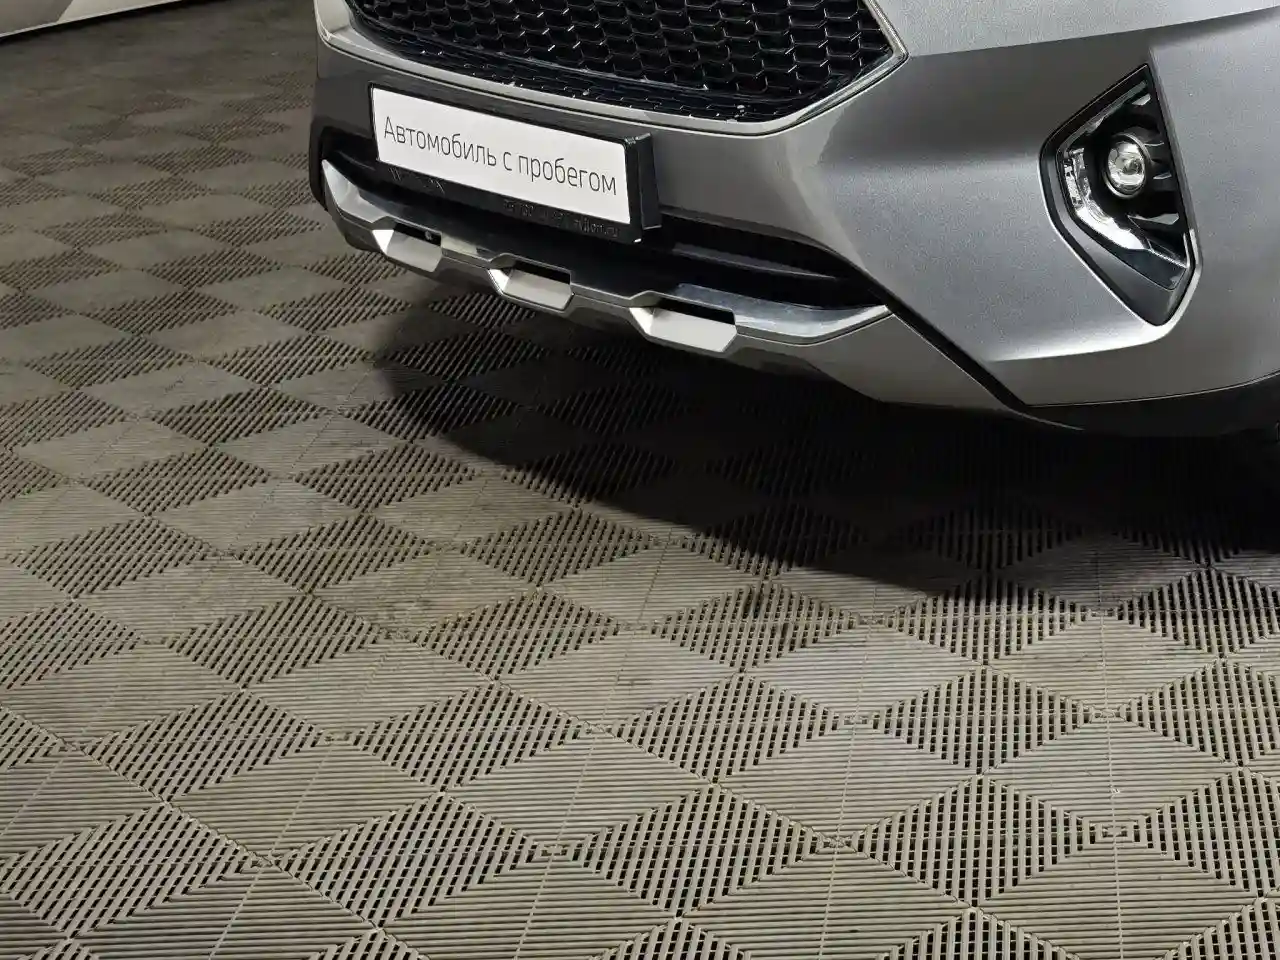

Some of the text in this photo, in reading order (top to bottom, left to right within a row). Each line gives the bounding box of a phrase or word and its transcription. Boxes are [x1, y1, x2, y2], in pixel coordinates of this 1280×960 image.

[383, 115, 617, 196] Автомобиль с пробегом
